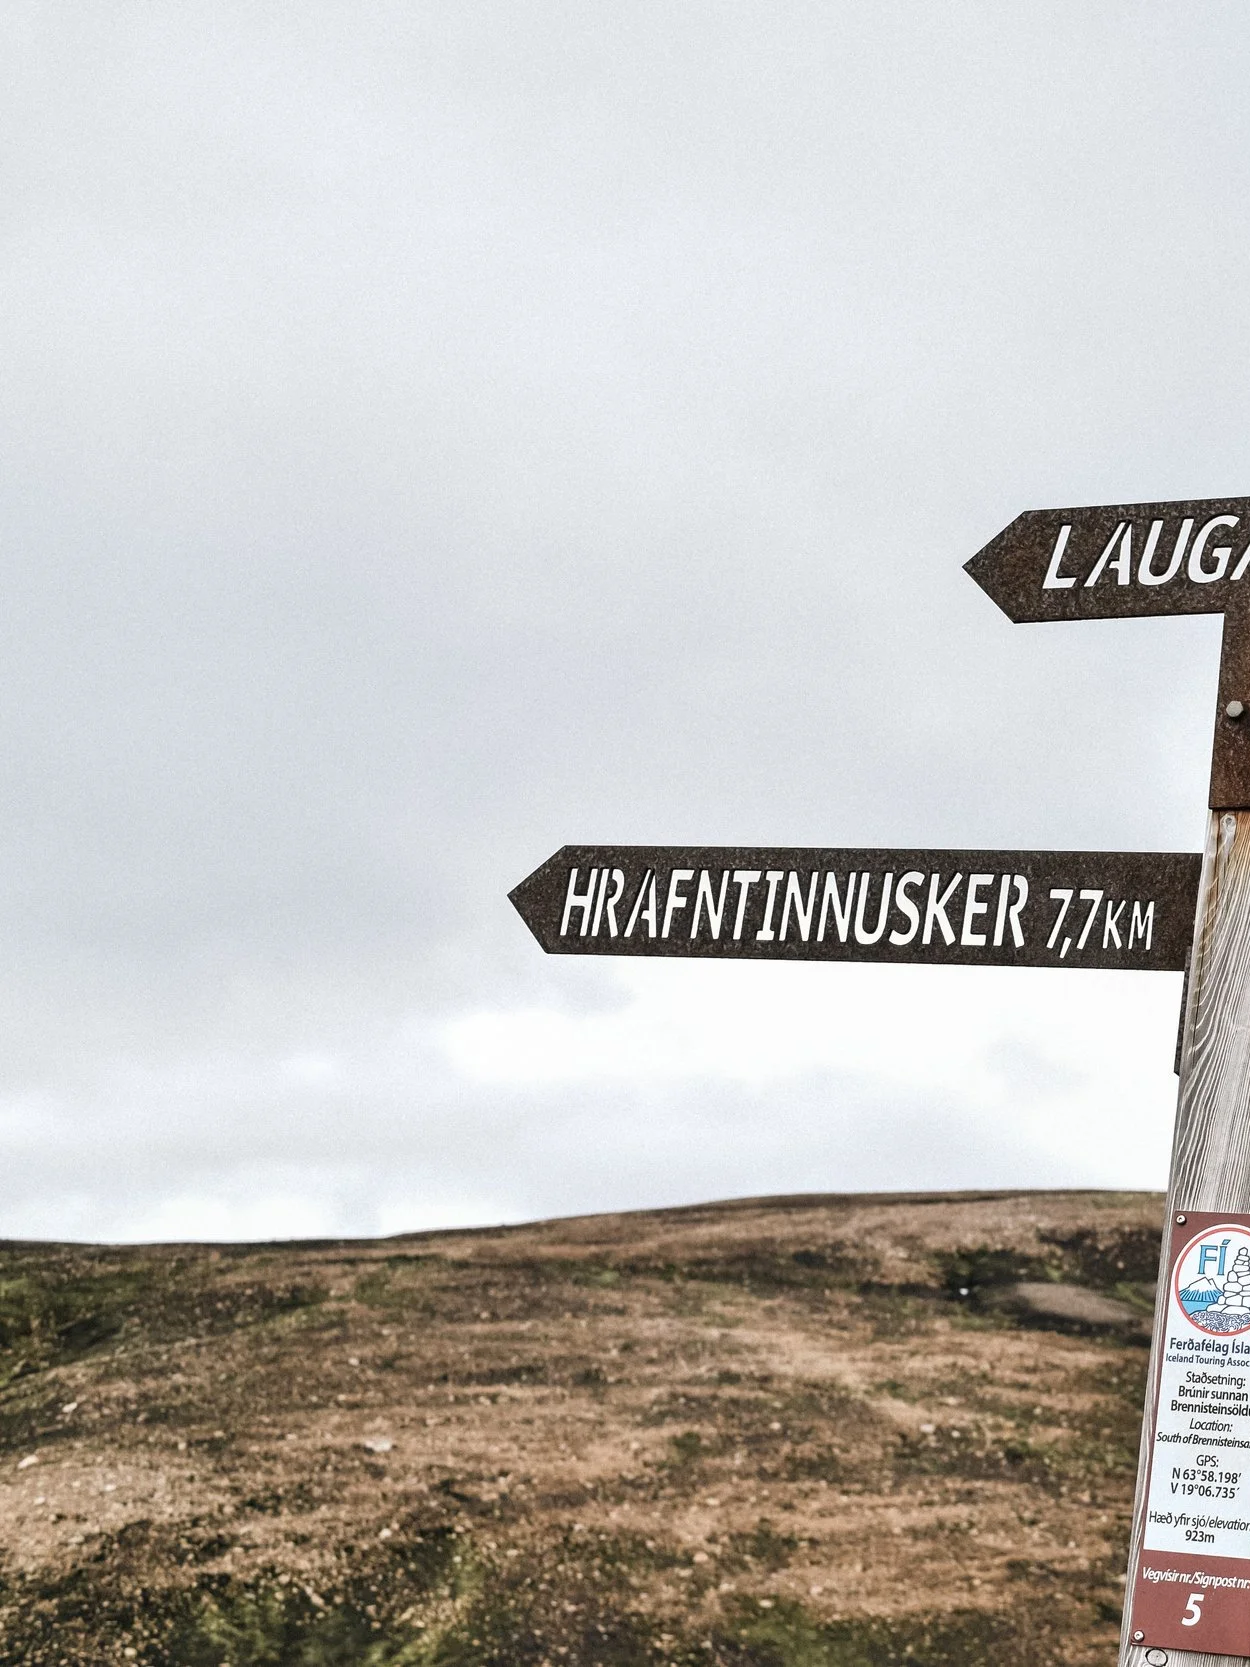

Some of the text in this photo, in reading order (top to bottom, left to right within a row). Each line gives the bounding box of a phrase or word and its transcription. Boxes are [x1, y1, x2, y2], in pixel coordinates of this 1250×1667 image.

[559, 867, 1025, 948] HRAFNTINNUSKER
[1197, 1239, 1231, 1276] FÍ
[1170, 1337, 1229, 1356] Ferðafélag
[1166, 1353, 1194, 1363] Iceland
[1195, 1355, 1226, 1367] Touring
[1186, 1371, 1246, 1389] Staðsetning:
[1178, 1386, 1249, 1401] Brúnir sunnan
[1189, 1418, 1233, 1432] Location:
[1156, 1432, 1182, 1443] South
[1182, 1434, 1193, 1445] of
[1196, 1454, 1219, 1467] GPS:
[1172, 1467, 1181, 1479] N
[1170, 1482, 1178, 1494] V
[1149, 1511, 1173, 1524] Hæð
[1173, 1513, 1191, 1528] yfir
[1185, 1530, 1215, 1543] 923m
[1142, 1567, 1179, 1583] Vegvísir
[1181, 1593, 1205, 1627] 5
